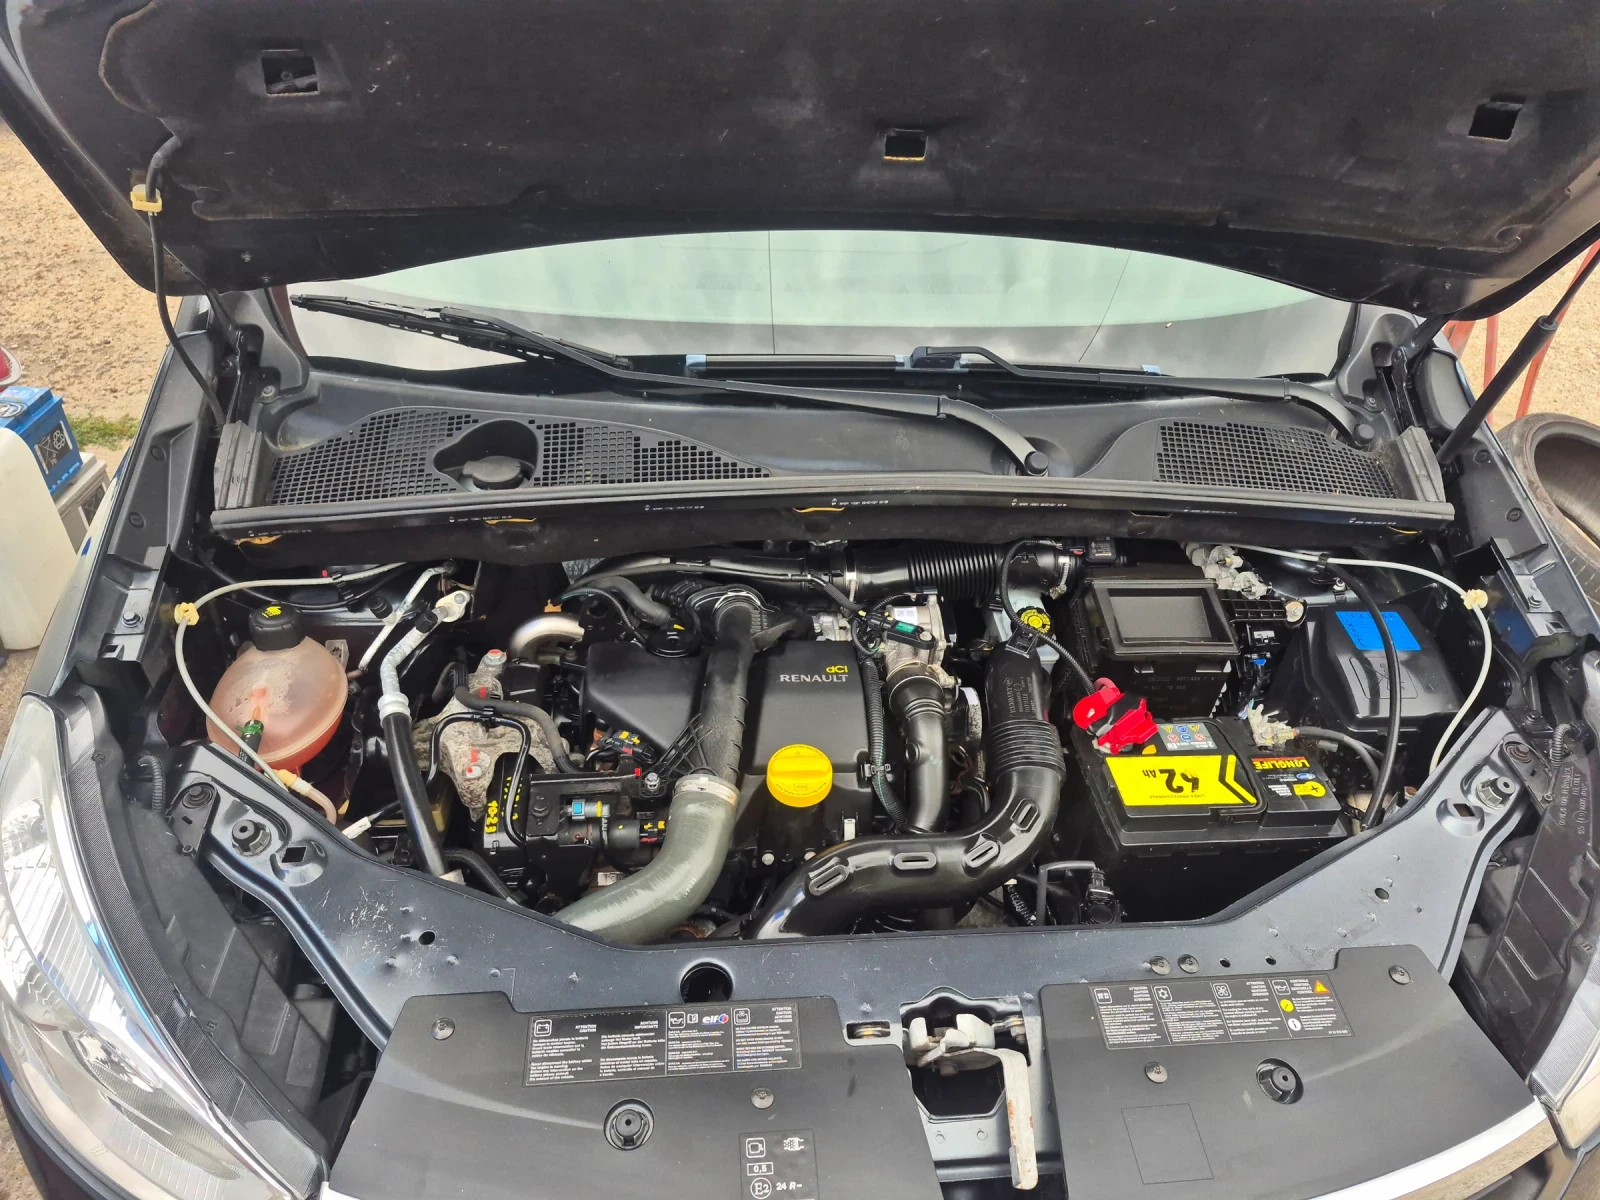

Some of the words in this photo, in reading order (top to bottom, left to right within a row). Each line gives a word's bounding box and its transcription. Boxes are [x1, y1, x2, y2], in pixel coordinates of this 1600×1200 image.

[780, 674, 849, 682] RENAULT
[1253, 759, 1310, 769] LONGLIFE
[1142, 769, 1157, 778] Ah
[702, 1015, 720, 1024] elf
[753, 1165, 767, 1173] 0,5
[754, 1182, 770, 1195] E2
[776, 1182, 787, 1191] 24
